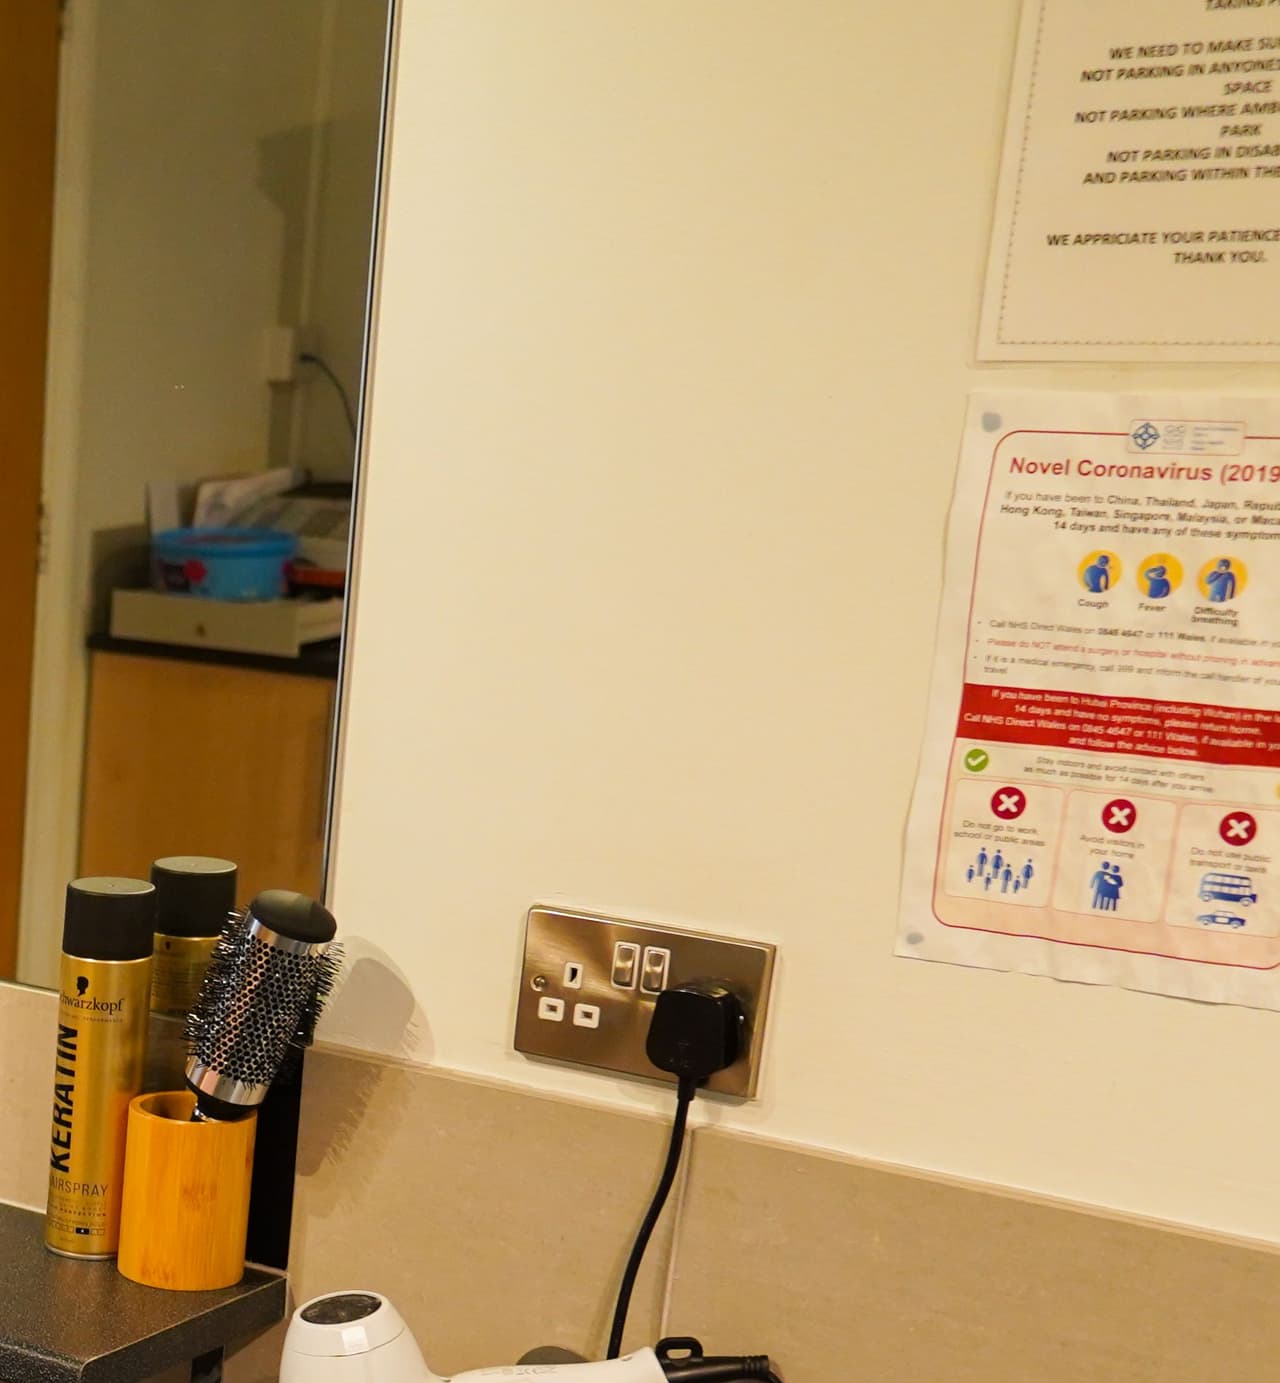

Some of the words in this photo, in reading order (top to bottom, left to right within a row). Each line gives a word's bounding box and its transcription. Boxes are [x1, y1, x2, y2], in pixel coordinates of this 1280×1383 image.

[1110, 46, 1133, 60] WE
[1137, 44, 1178, 58] NEED
[1183, 42, 1204, 55] TO
[1208, 38, 1254, 53] MAKE
[1080, 68, 1114, 82] NOT
[1116, 64, 1184, 81] PARKING
[1188, 63, 1205, 76] IN
[1224, 80, 1273, 95] SPACE
[1074, 110, 1106, 124] NOT
[1110, 107, 1178, 122] PARKING
[1182, 104, 1237, 118] WHERE
[1220, 124, 1262, 138] PARK
[1106, 150, 1140, 164] NOT
[1142, 147, 1211, 161] PARKING
[1214, 146, 1231, 158] IN
[1083, 172, 1116, 185] AND
[1119, 169, 1187, 183] PARKING
[1191, 166, 1248, 180] WITHIN
[1046, 234, 1068, 246] WE
[1162, 231, 1204, 244] YOUR
[1174, 251, 1225, 264] THANK
[1010, 457, 1071, 476] Novel
[1077, 459, 1213, 481] Coronavirus
[1000, 504, 1029, 516] Hong
[1077, 599, 1110, 610] Cough
[1138, 603, 1166, 612] Fever
[50, 1023, 78, 1174] KERATIN
